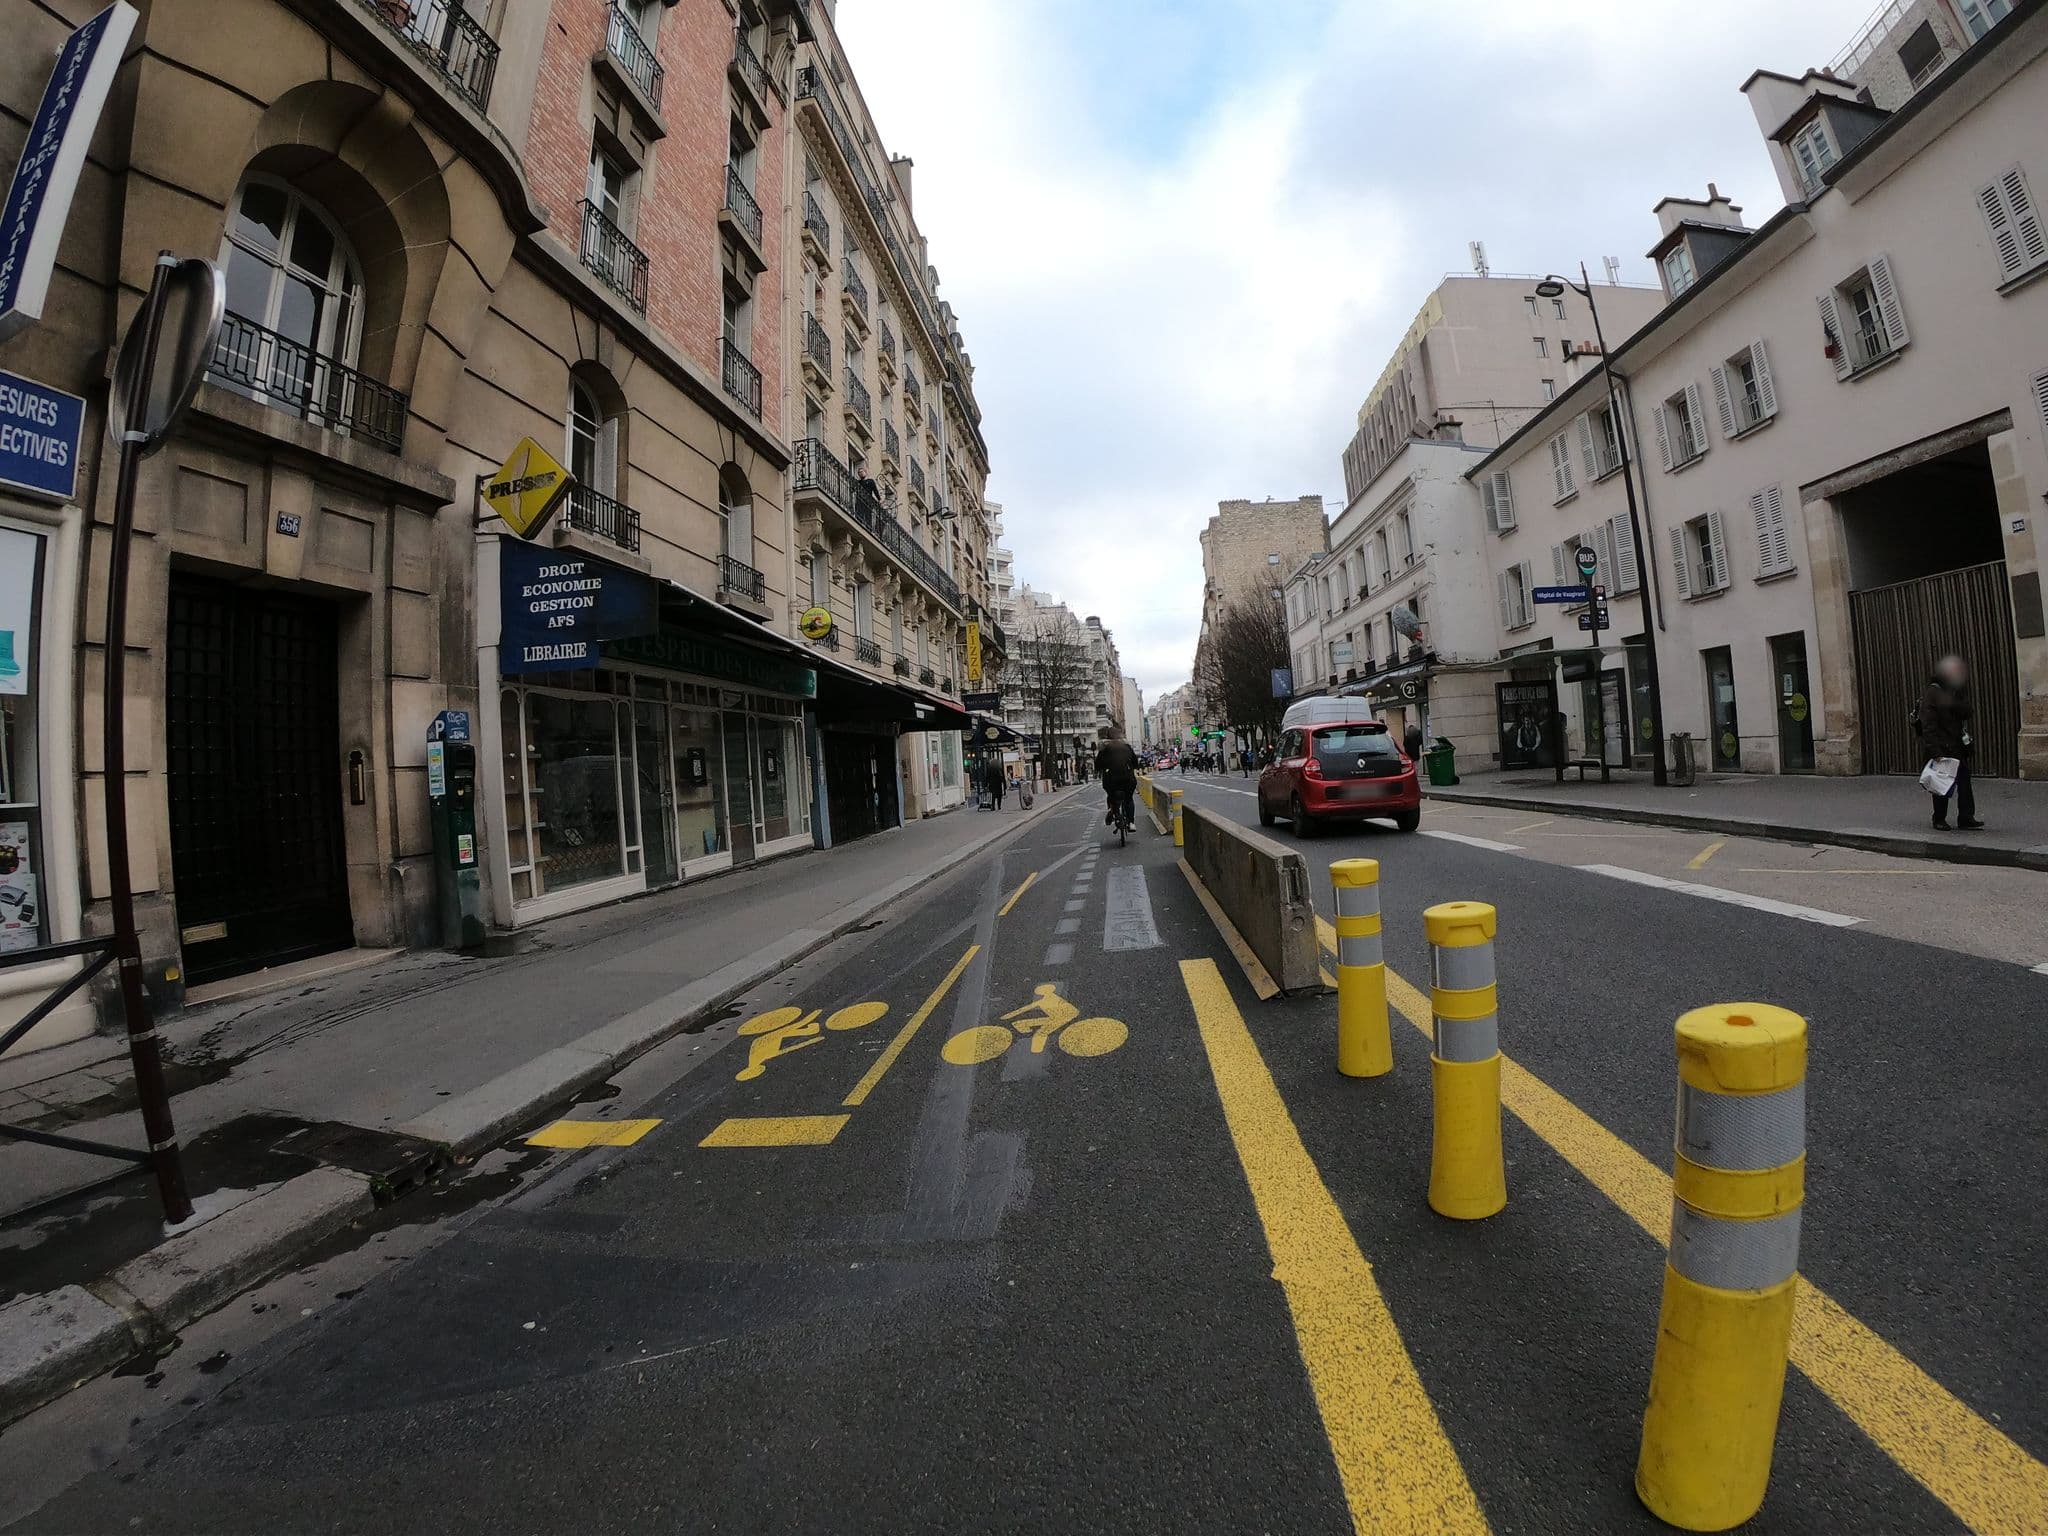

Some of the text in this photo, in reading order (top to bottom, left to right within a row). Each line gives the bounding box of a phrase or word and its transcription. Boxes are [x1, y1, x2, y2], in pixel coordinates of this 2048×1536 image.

[42, 21, 96, 149] CENTRALE
[21, 140, 58, 177] DES
[0, 384, 58, 427] ESURES
[489, 471, 557, 499] PRESSE
[280, 515, 299, 534] 356
[1579, 553, 1594, 562] BUS
[538, 563, 585, 579] DROIT
[522, 578, 602, 597] ECONOMIE
[529, 596, 594, 613] GESTION
[523, 642, 587, 662] LIBRAIRIE
[967, 624, 980, 678] PIZZA
[435, 719, 445, 740] P
